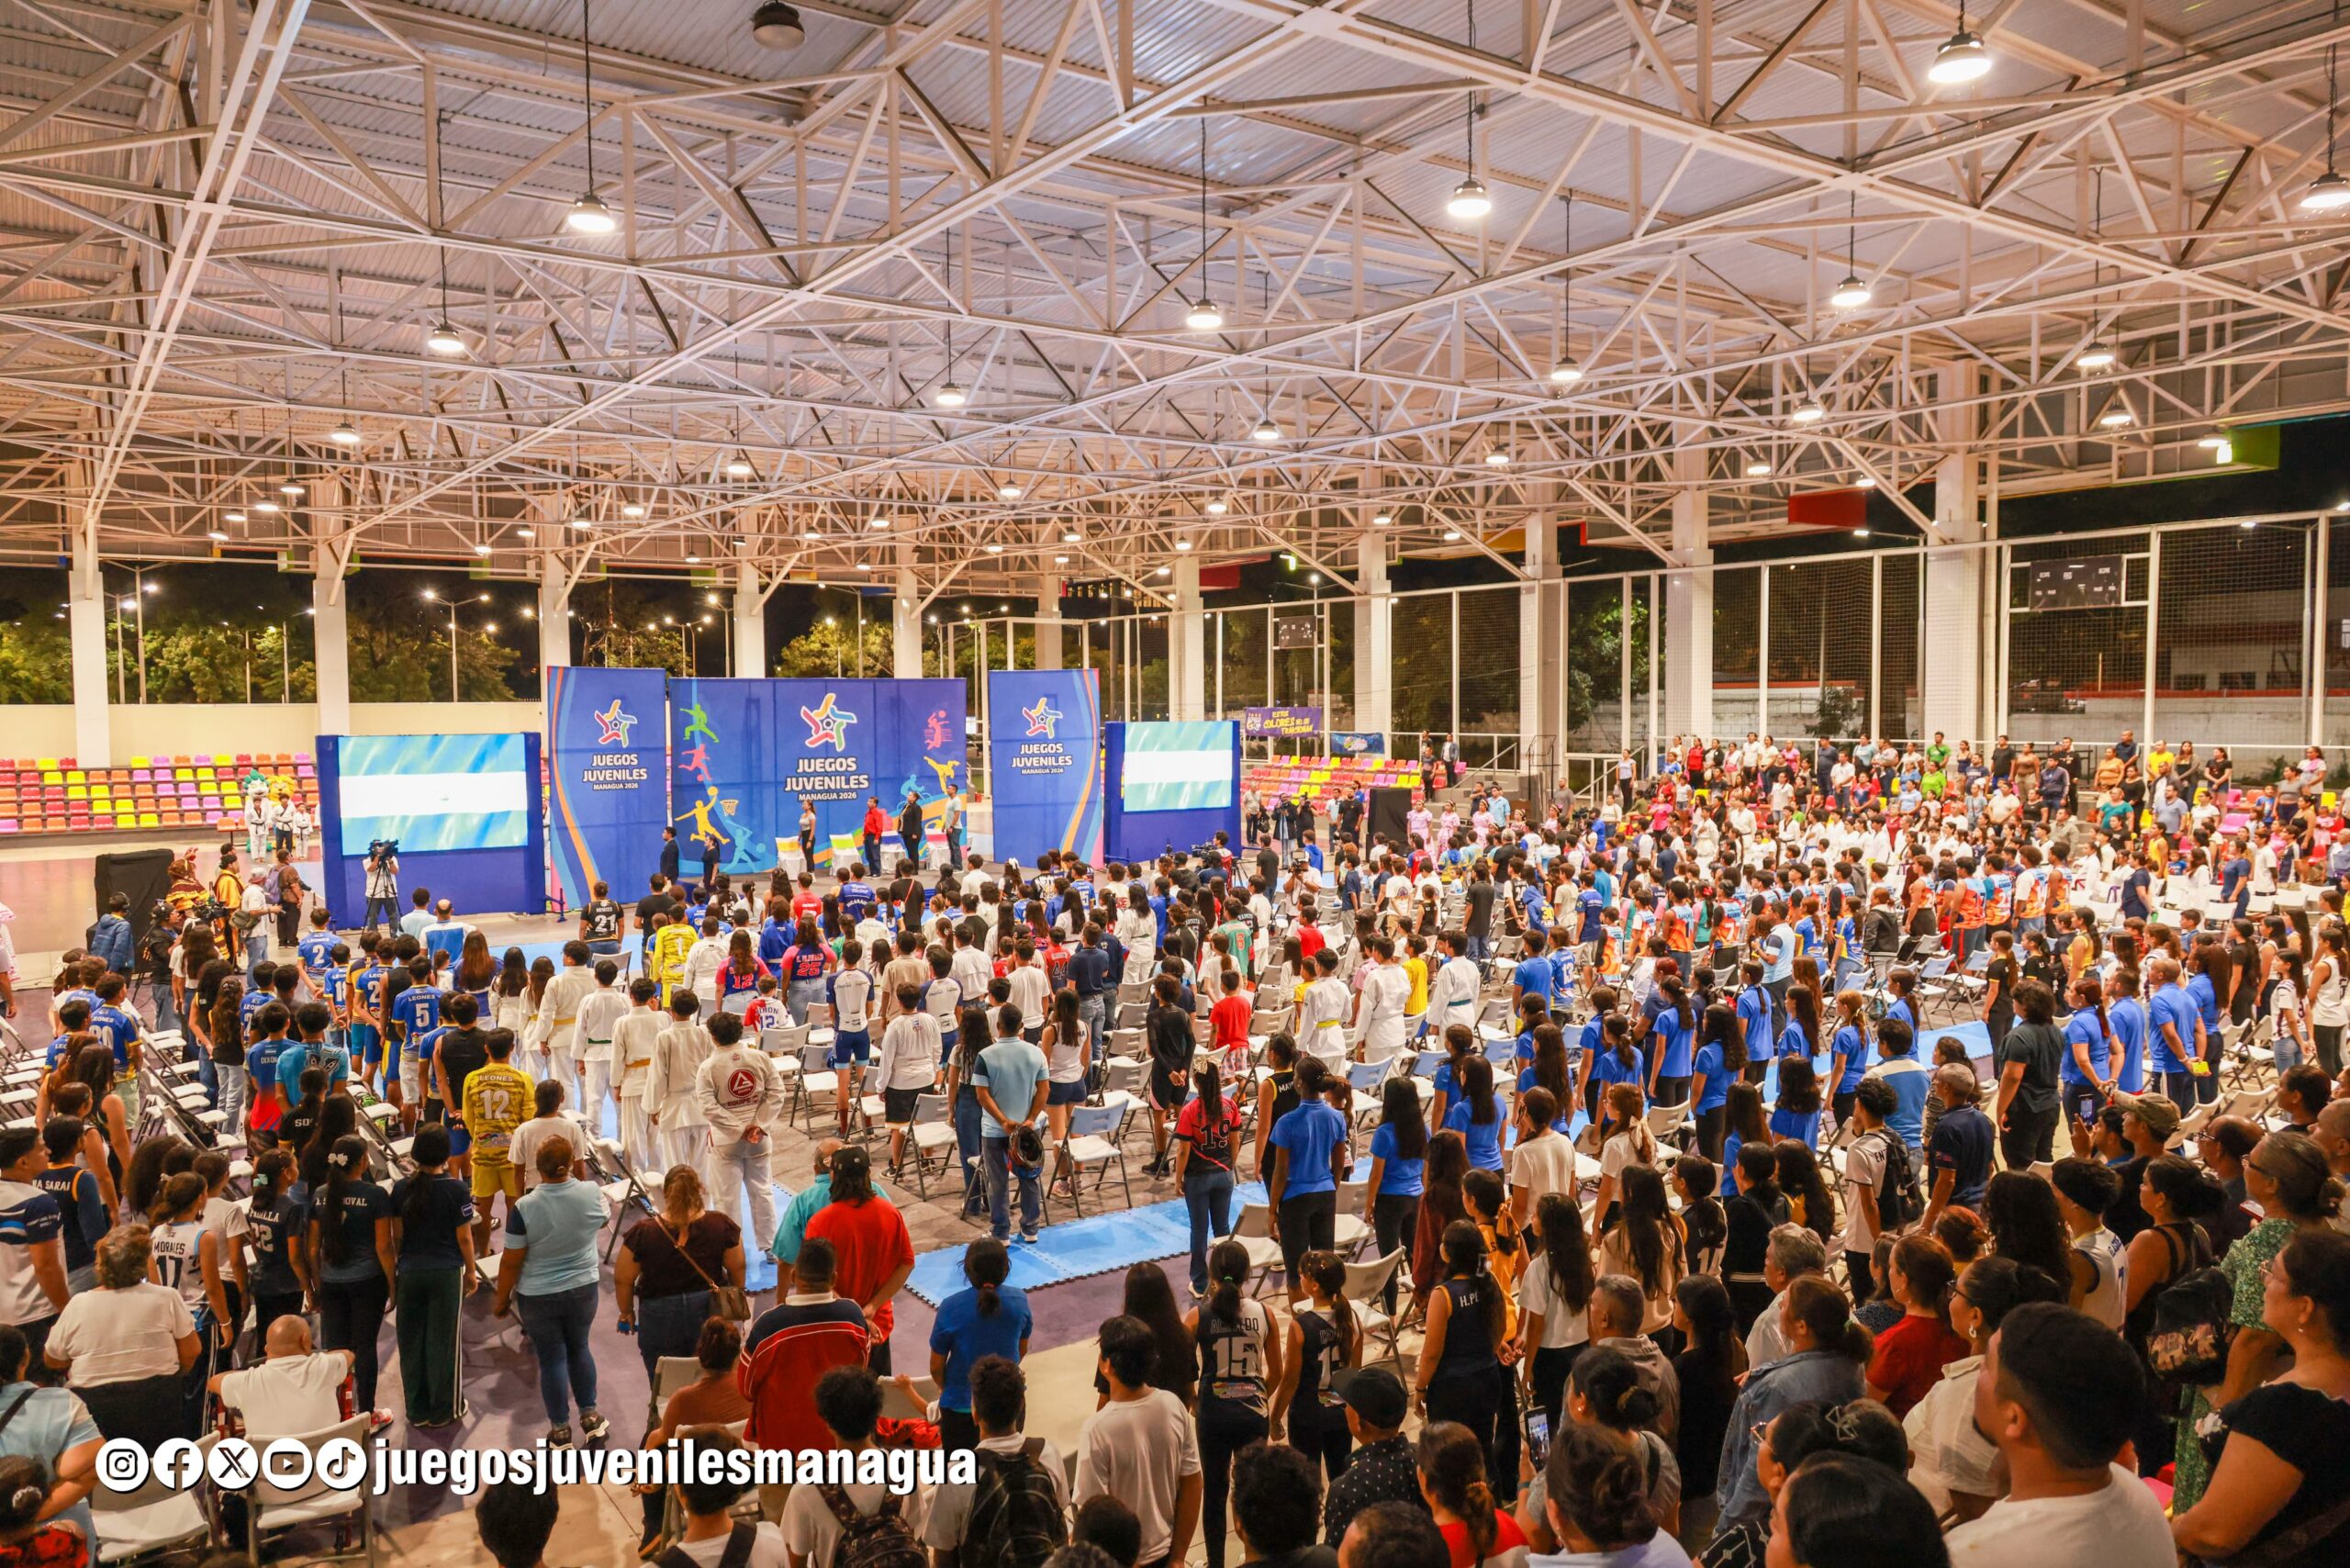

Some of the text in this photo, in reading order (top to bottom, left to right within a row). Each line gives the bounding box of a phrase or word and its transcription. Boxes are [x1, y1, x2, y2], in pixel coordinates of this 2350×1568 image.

[1263, 717, 1295, 728] COLORES
[1020, 743, 1064, 755] JUEGOS
[592, 754, 639, 767] JUEGOS
[797, 756, 857, 773] JUEGOS
[1012, 756, 1073, 767] JUVENILES
[583, 768, 648, 782] JUVENILES
[785, 774, 869, 791] JUVENILES
[839, 791, 856, 800] 2026
[722, 901, 734, 916] 13
[594, 914, 617, 932] 21
[676, 937, 684, 955] 1
[312, 945, 325, 964] 2
[797, 962, 822, 977] 25
[733, 975, 754, 989] 12
[415, 1003, 430, 1027] 5
[760, 1015, 775, 1028] 12
[480, 1090, 509, 1119] 12
[1200, 1120, 1231, 1150] 19
[45, 1181, 71, 1191] SARAI
[154, 1241, 185, 1255] MORALES
[1213, 1337, 1259, 1378] 15
